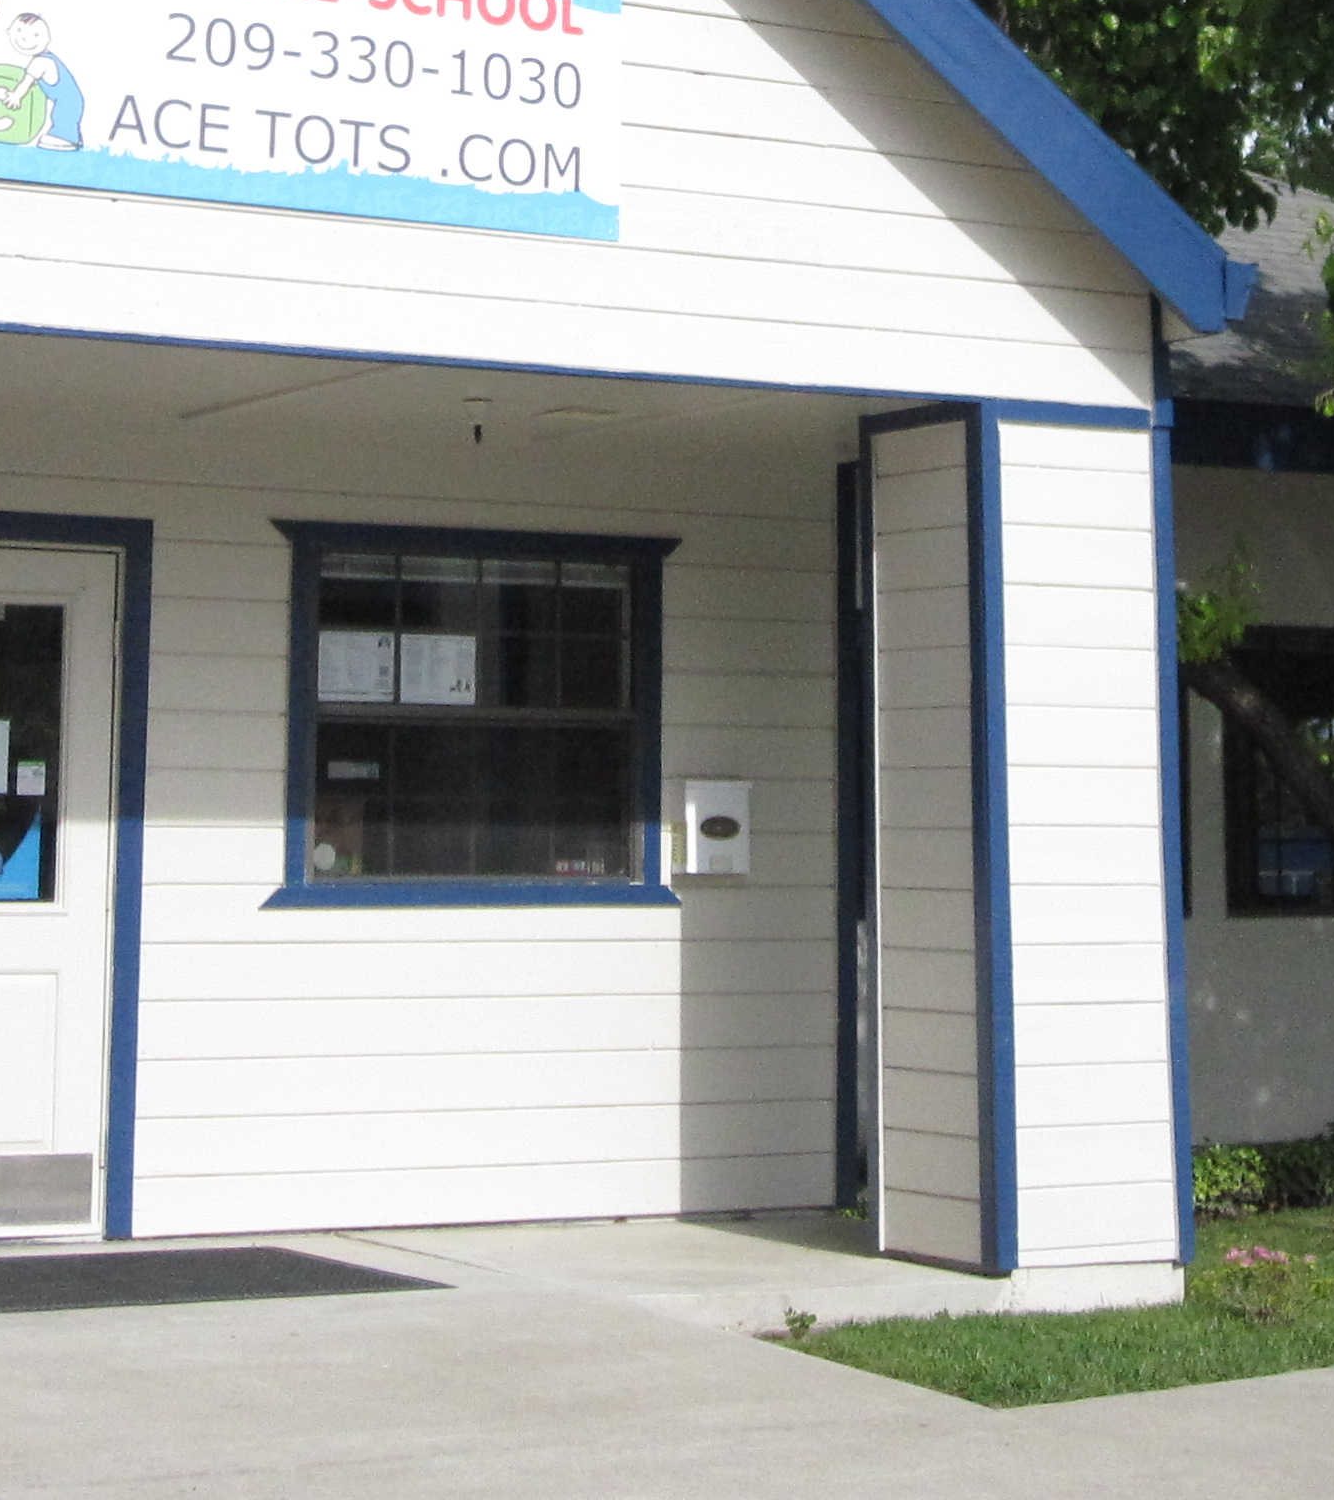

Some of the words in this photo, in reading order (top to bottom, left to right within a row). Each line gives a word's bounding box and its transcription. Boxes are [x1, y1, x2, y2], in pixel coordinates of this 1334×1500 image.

[166, 12, 581, 109] 209-330-1030
[108, 94, 230, 154] ACE
[255, 109, 411, 174] TOTS
[440, 134, 581, 193] .COM
